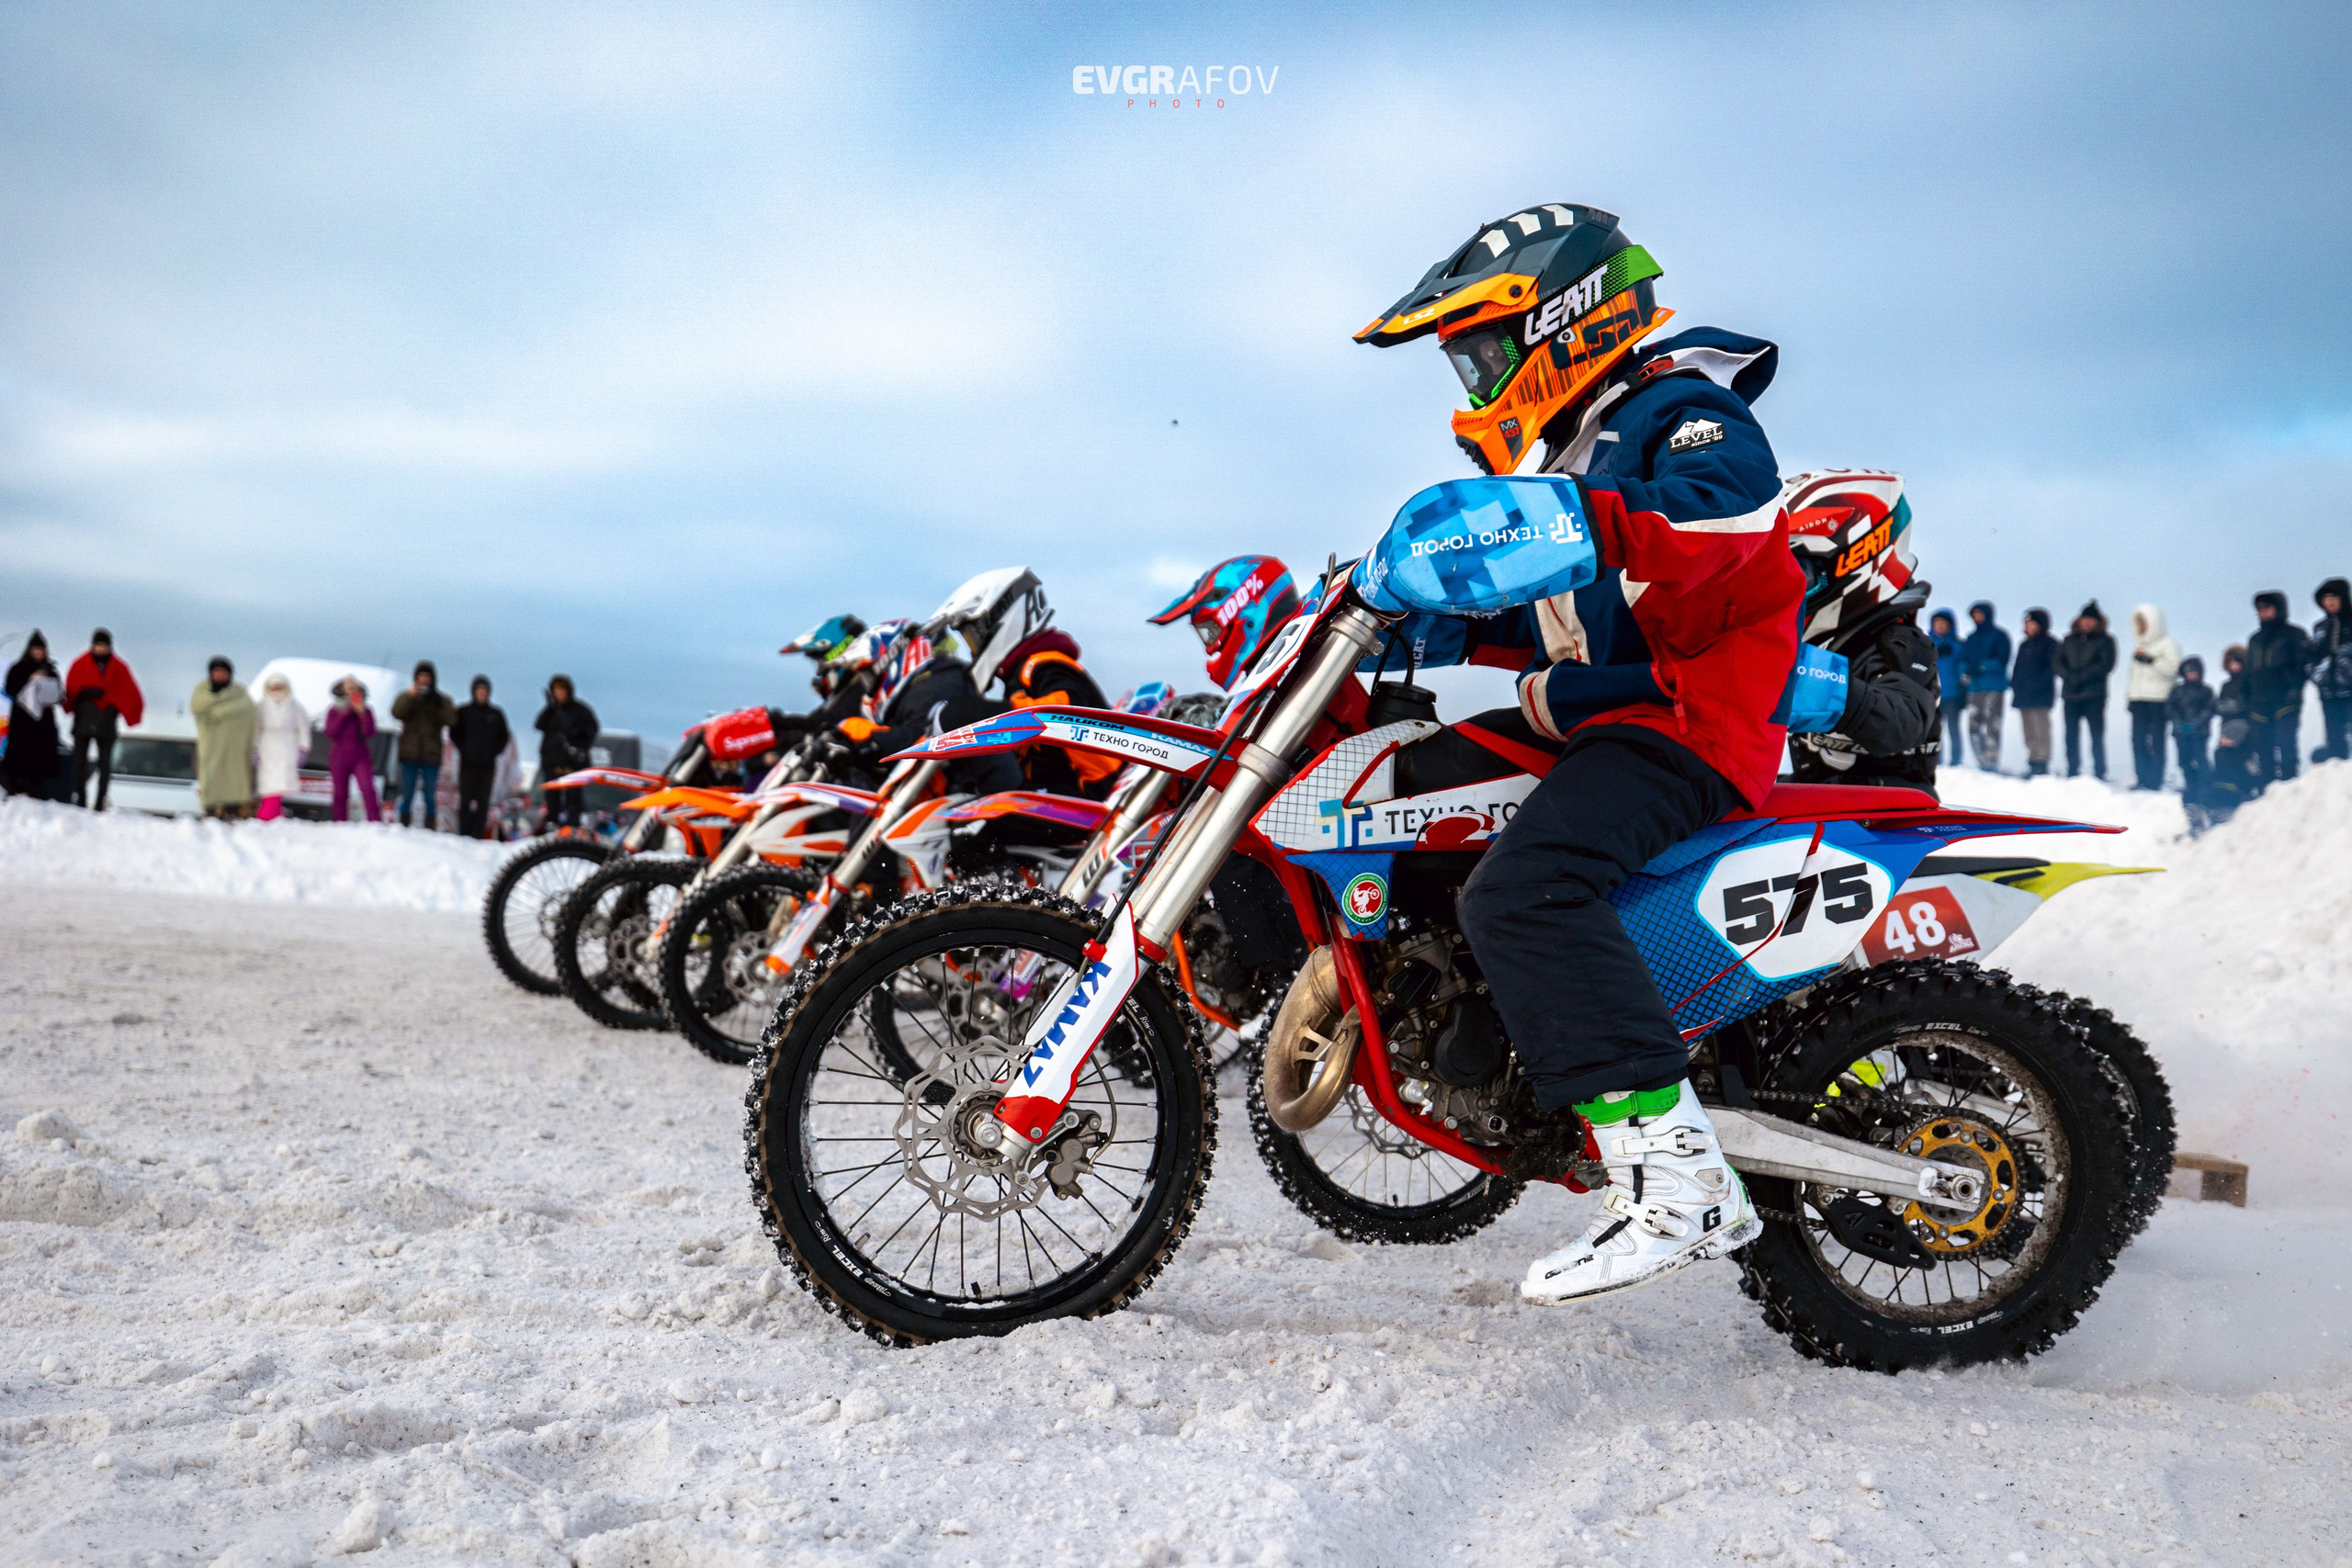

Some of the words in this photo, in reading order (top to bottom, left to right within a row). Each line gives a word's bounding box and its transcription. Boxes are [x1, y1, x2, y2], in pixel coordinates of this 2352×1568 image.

[1524, 264, 1609, 345] LEATT
[1403, 308, 1435, 325] LS2
[1500, 418, 1519, 431] MX
[1505, 426, 1521, 438] 437
[1670, 426, 1723, 448] LEVEL
[1690, 439, 1711, 447] since
[1410, 534, 1474, 557] ГОРОД
[1479, 525, 1544, 546] ТЕХНО
[1835, 515, 1894, 577] LEATT
[1216, 573, 1264, 627] 100%
[1809, 667, 1847, 684] ГОРОД
[1093, 731, 1130, 749] ТЕХНО
[1132, 741, 1169, 760] ГОРОД
[1151, 732, 1212, 755] KAMAZ
[1723, 862, 1874, 946] 575
[1884, 901, 1947, 954] 48
[1023, 962, 1113, 1089] KAMAZ
[1925, 1022, 1962, 1031] EXCEL
[1702, 1205, 1722, 1233] G
[832, 1245, 864, 1278] EXCEL
[1938, 1321, 1974, 1335] EXCEL
